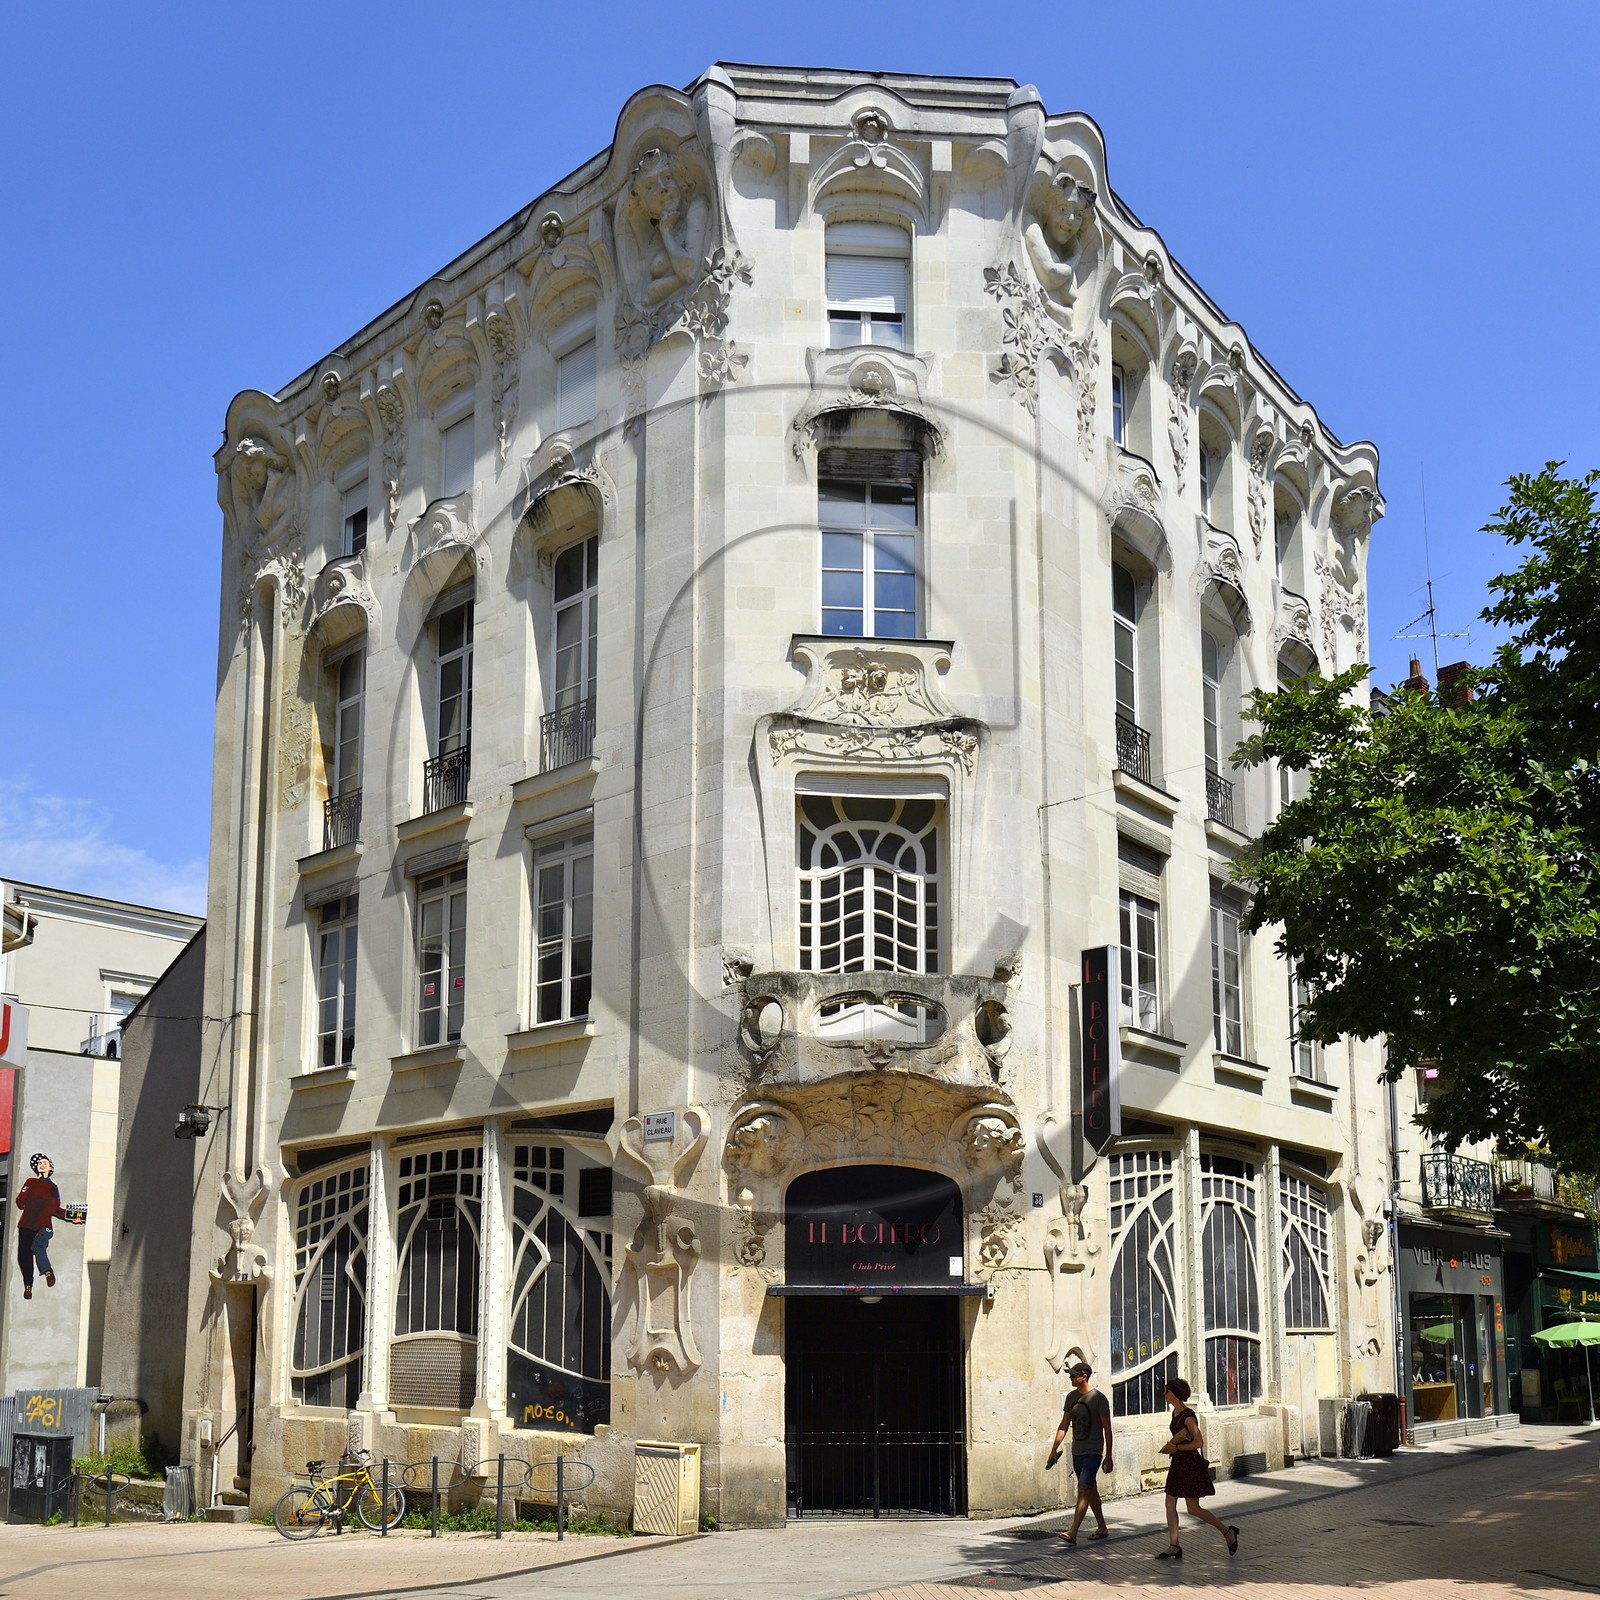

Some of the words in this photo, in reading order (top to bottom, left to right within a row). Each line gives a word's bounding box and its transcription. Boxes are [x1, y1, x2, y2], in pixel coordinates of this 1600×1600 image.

[1085, 959, 1105, 984] Le
[655, 1117, 668, 1125] RUE
[646, 1126, 672, 1136] CLAVEAU
[1034, 1195, 1043, 1205] 38
[809, 1222, 833, 1244] LE
[842, 1217, 941, 1244] BOLÉRO
[1413, 1245, 1444, 1266] VOIR
[1449, 1254, 1458, 1269] &
[1461, 1250, 1491, 1271] PLUS
[852, 1262, 873, 1271] Club
[874, 1262, 897, 1271] Privé
